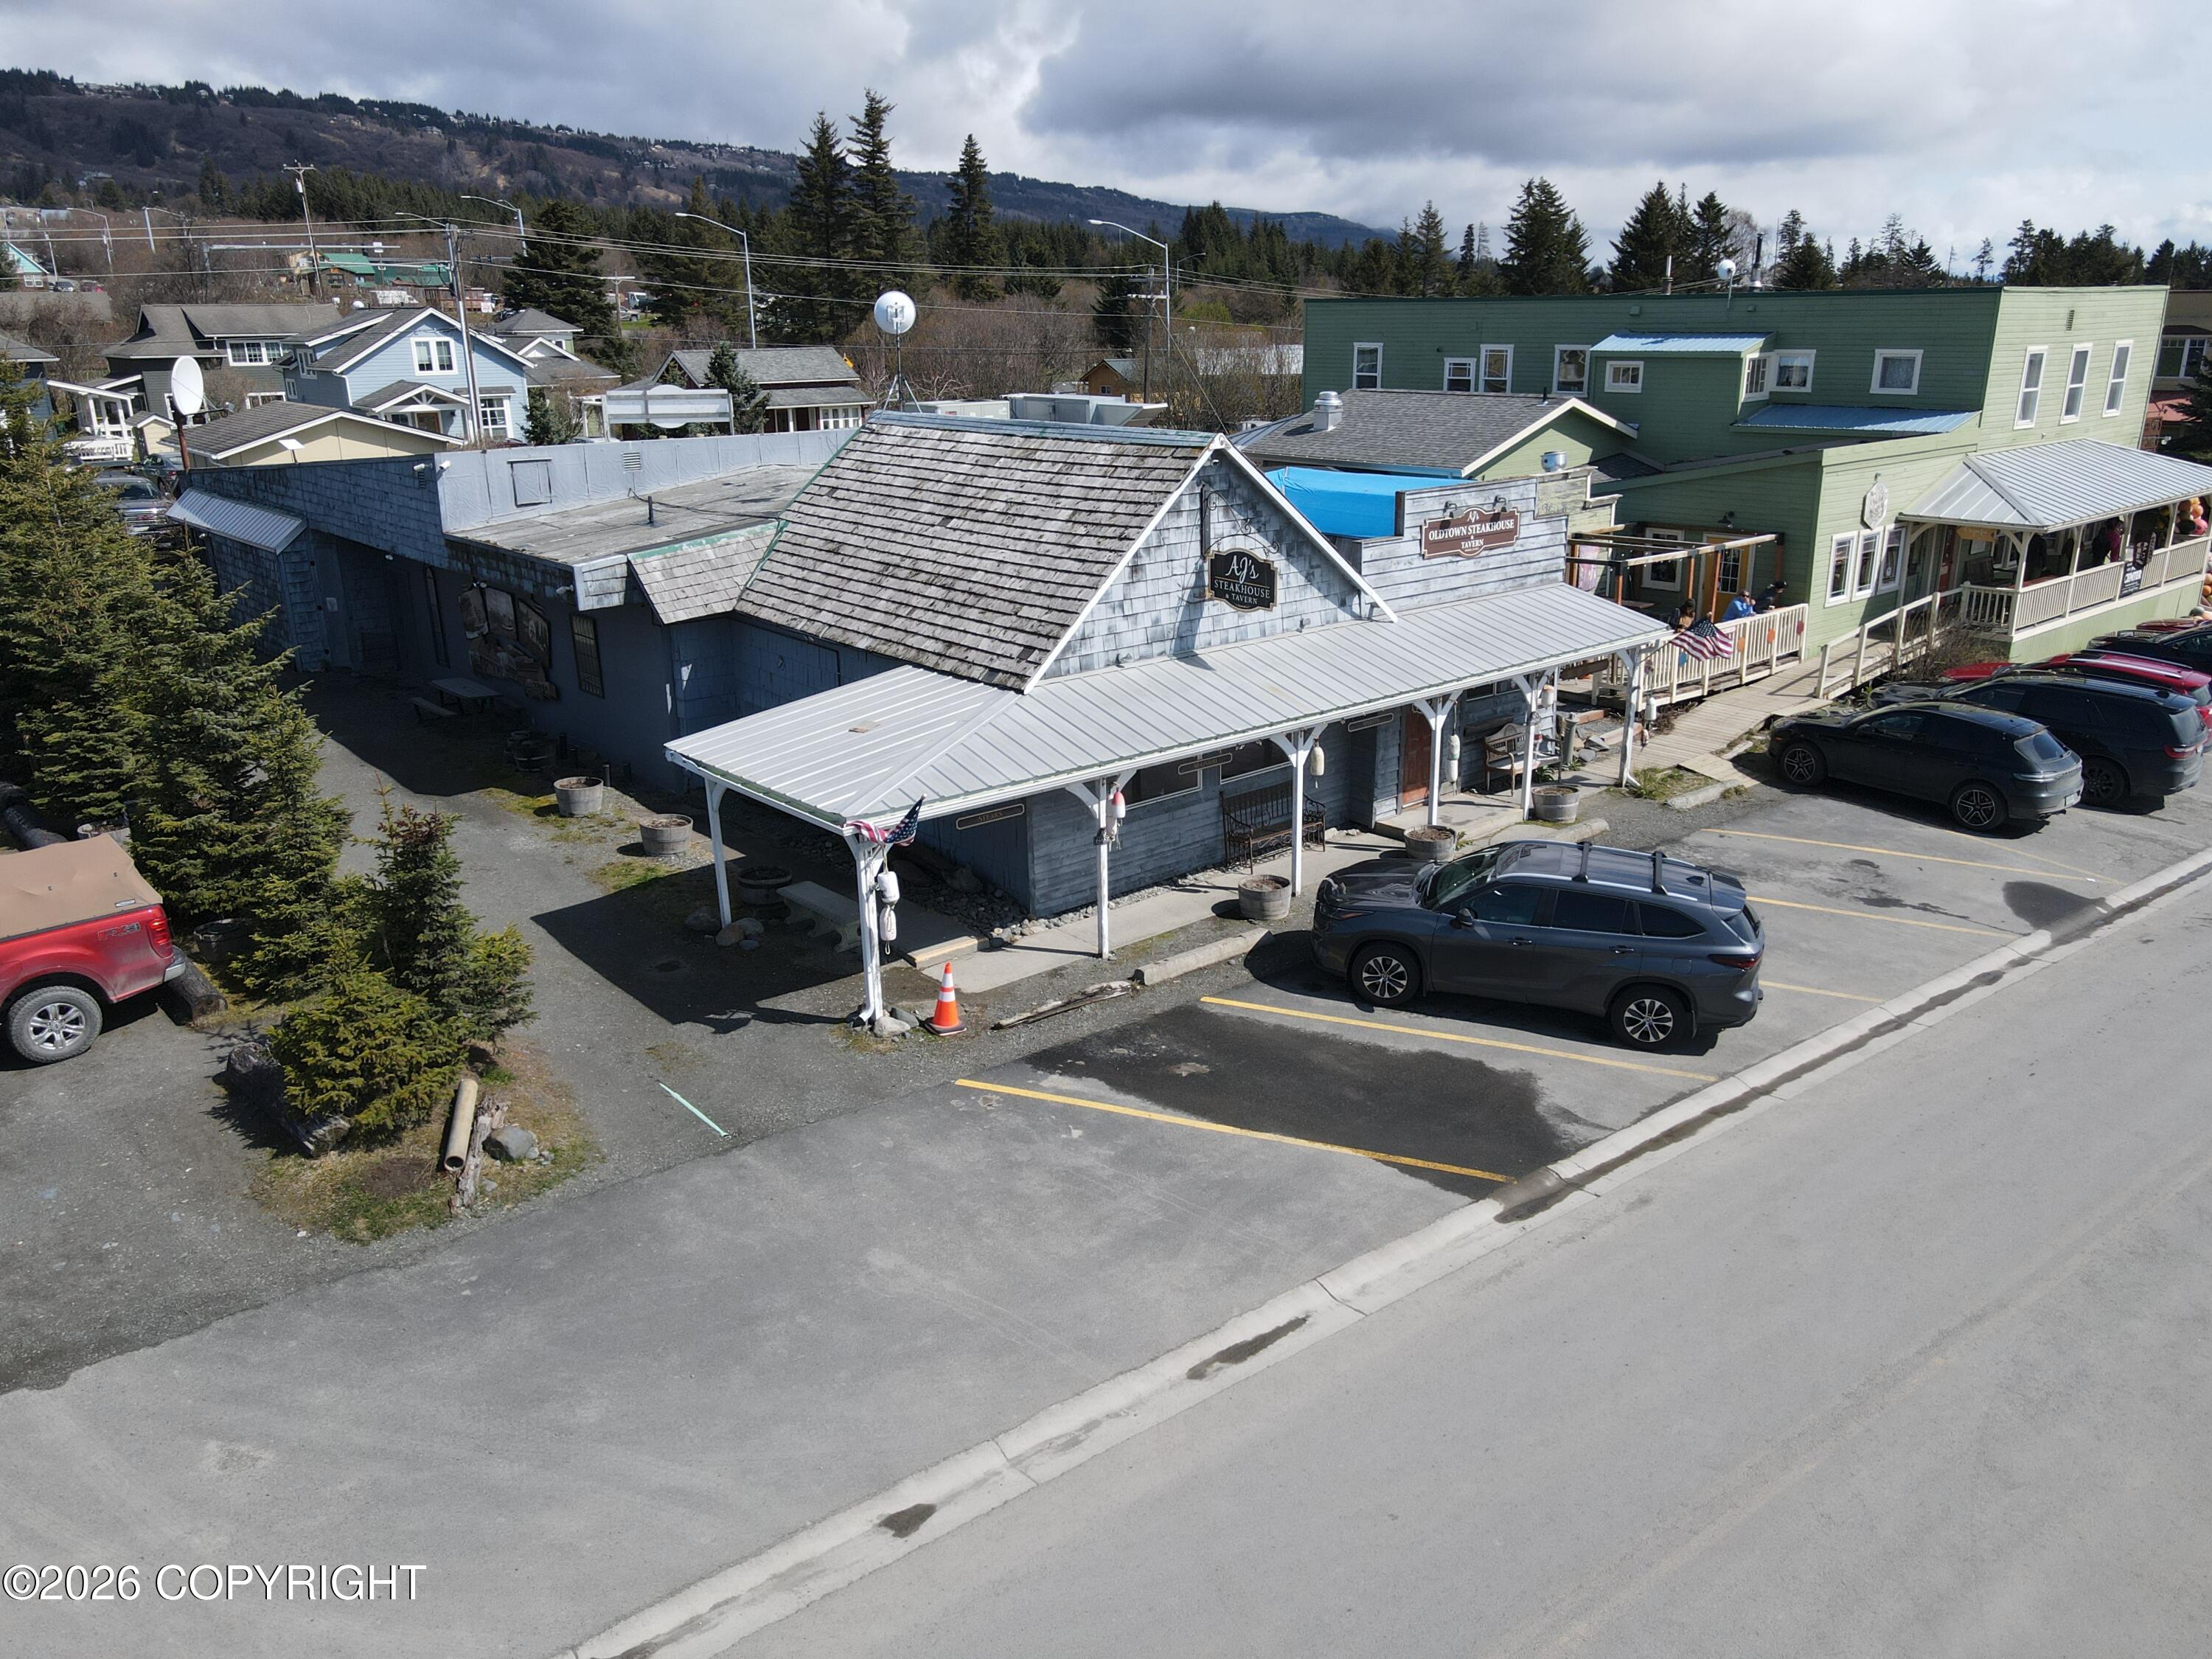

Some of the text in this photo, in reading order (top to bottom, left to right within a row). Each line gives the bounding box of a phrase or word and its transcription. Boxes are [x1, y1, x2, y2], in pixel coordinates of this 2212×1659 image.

[1429, 519, 1514, 540] OLDTOWN STEAKHOUSE
[1461, 538, 1484, 549] TAVERN
[1225, 554, 1259, 583] AJ's
[1214, 579, 1270, 599] STEAKHOUSE
[1231, 593, 1257, 605] TAVERN
[978, 811, 1003, 821] STEAKS
[97, 922, 142, 942] FX4
